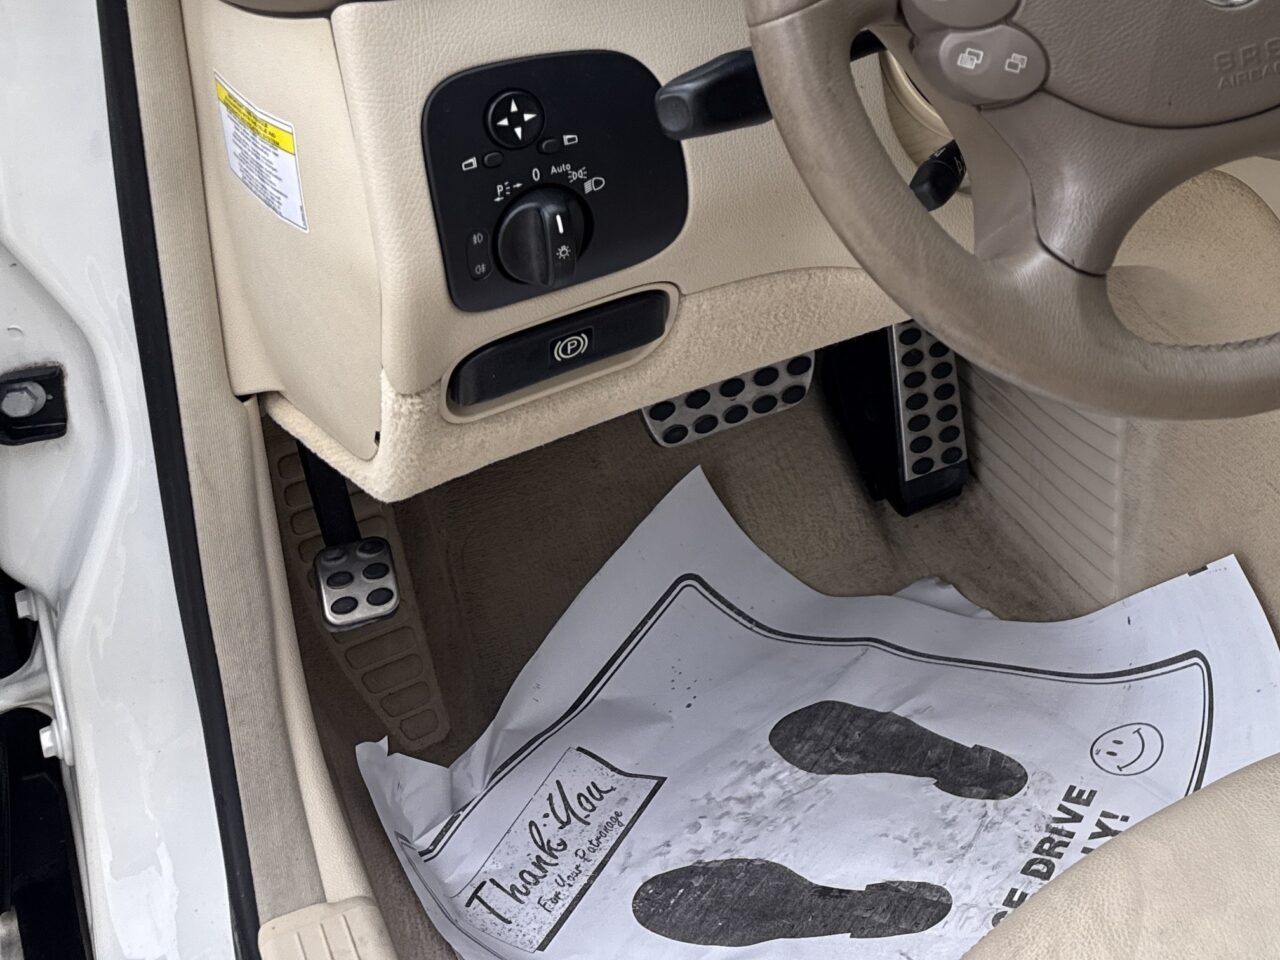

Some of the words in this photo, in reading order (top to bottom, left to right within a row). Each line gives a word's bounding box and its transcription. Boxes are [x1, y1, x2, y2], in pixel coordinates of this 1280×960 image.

[532, 167, 540, 182] 0
[550, 163, 571, 175] Auto
[465, 820, 568, 925] Thank
[547, 780, 617, 830] You
[537, 891, 567, 913] For
[555, 863, 582, 888] Your
[575, 810, 626, 862] Patronage
[1020, 784, 1098, 881] DRIVE
